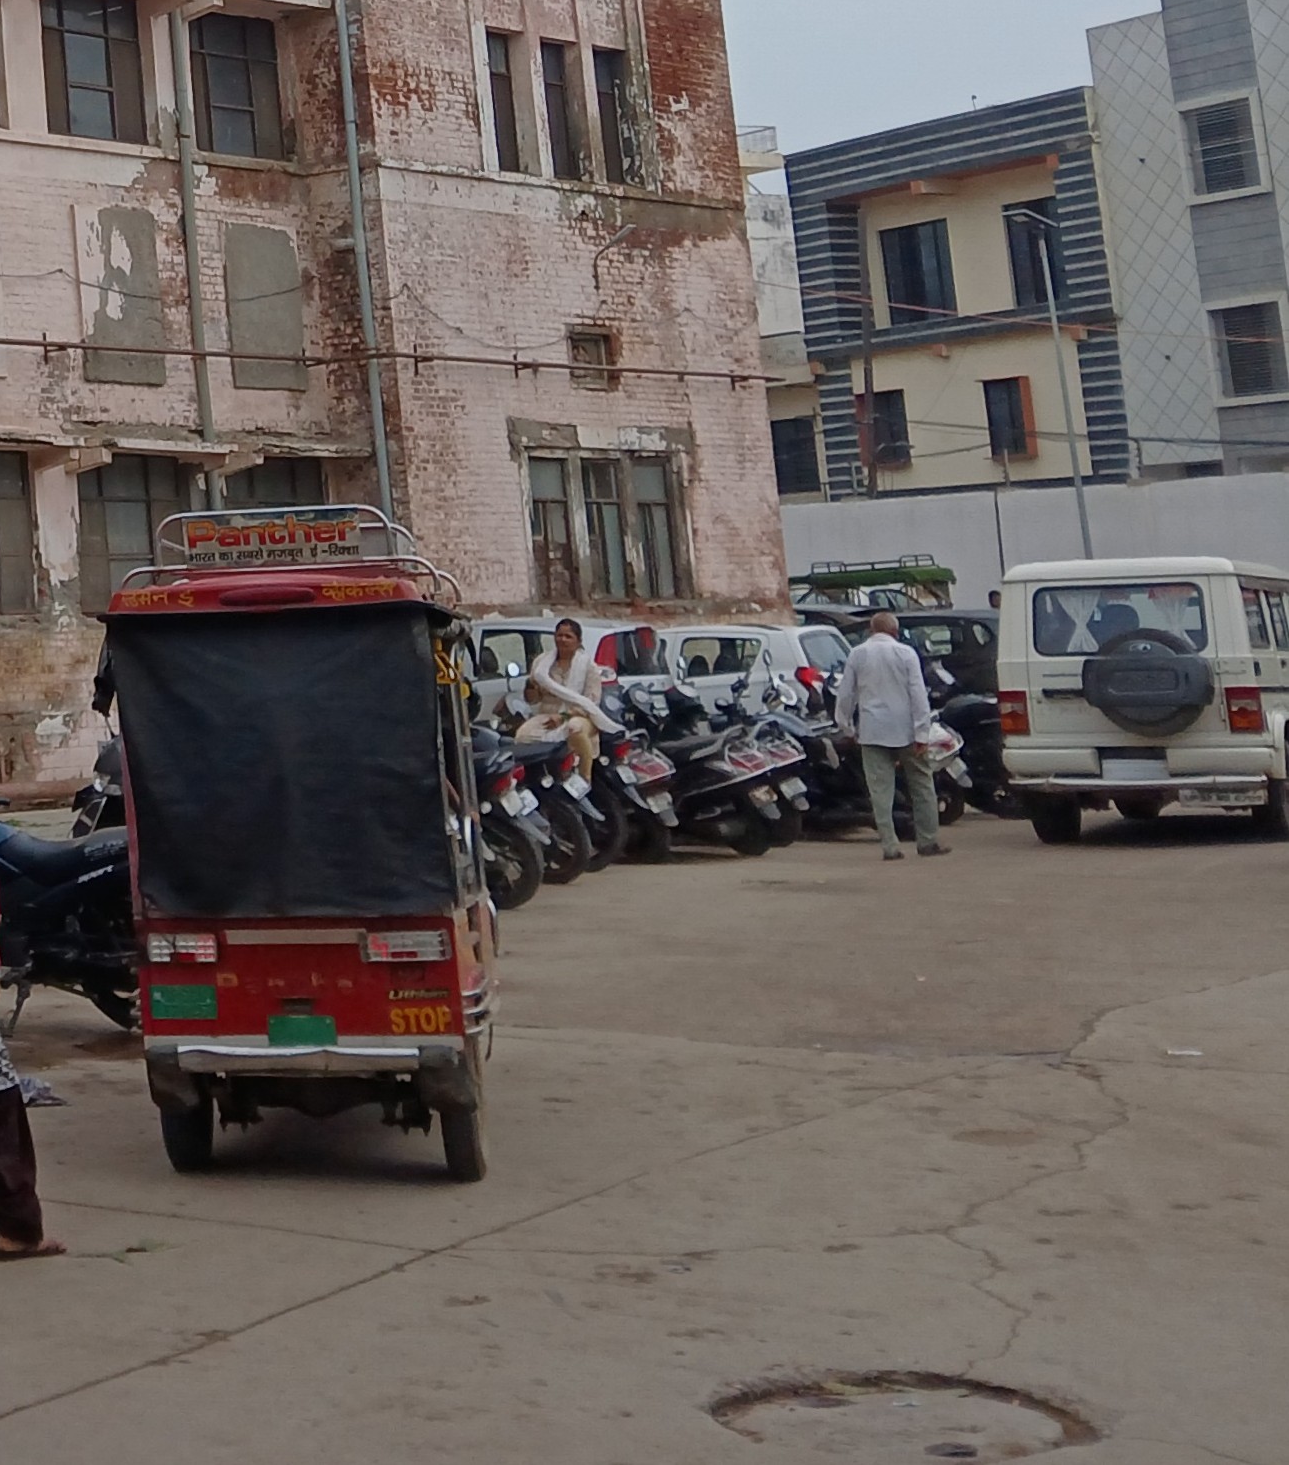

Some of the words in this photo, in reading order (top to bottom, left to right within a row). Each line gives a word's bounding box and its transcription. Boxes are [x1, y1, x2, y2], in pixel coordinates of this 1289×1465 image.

[186, 513, 358, 549] Panther
[189, 552, 216, 563] भारत
[218, 550, 234, 562] का
[236, 546, 264, 561] सबसे
[390, 1005, 452, 1034] STOP
